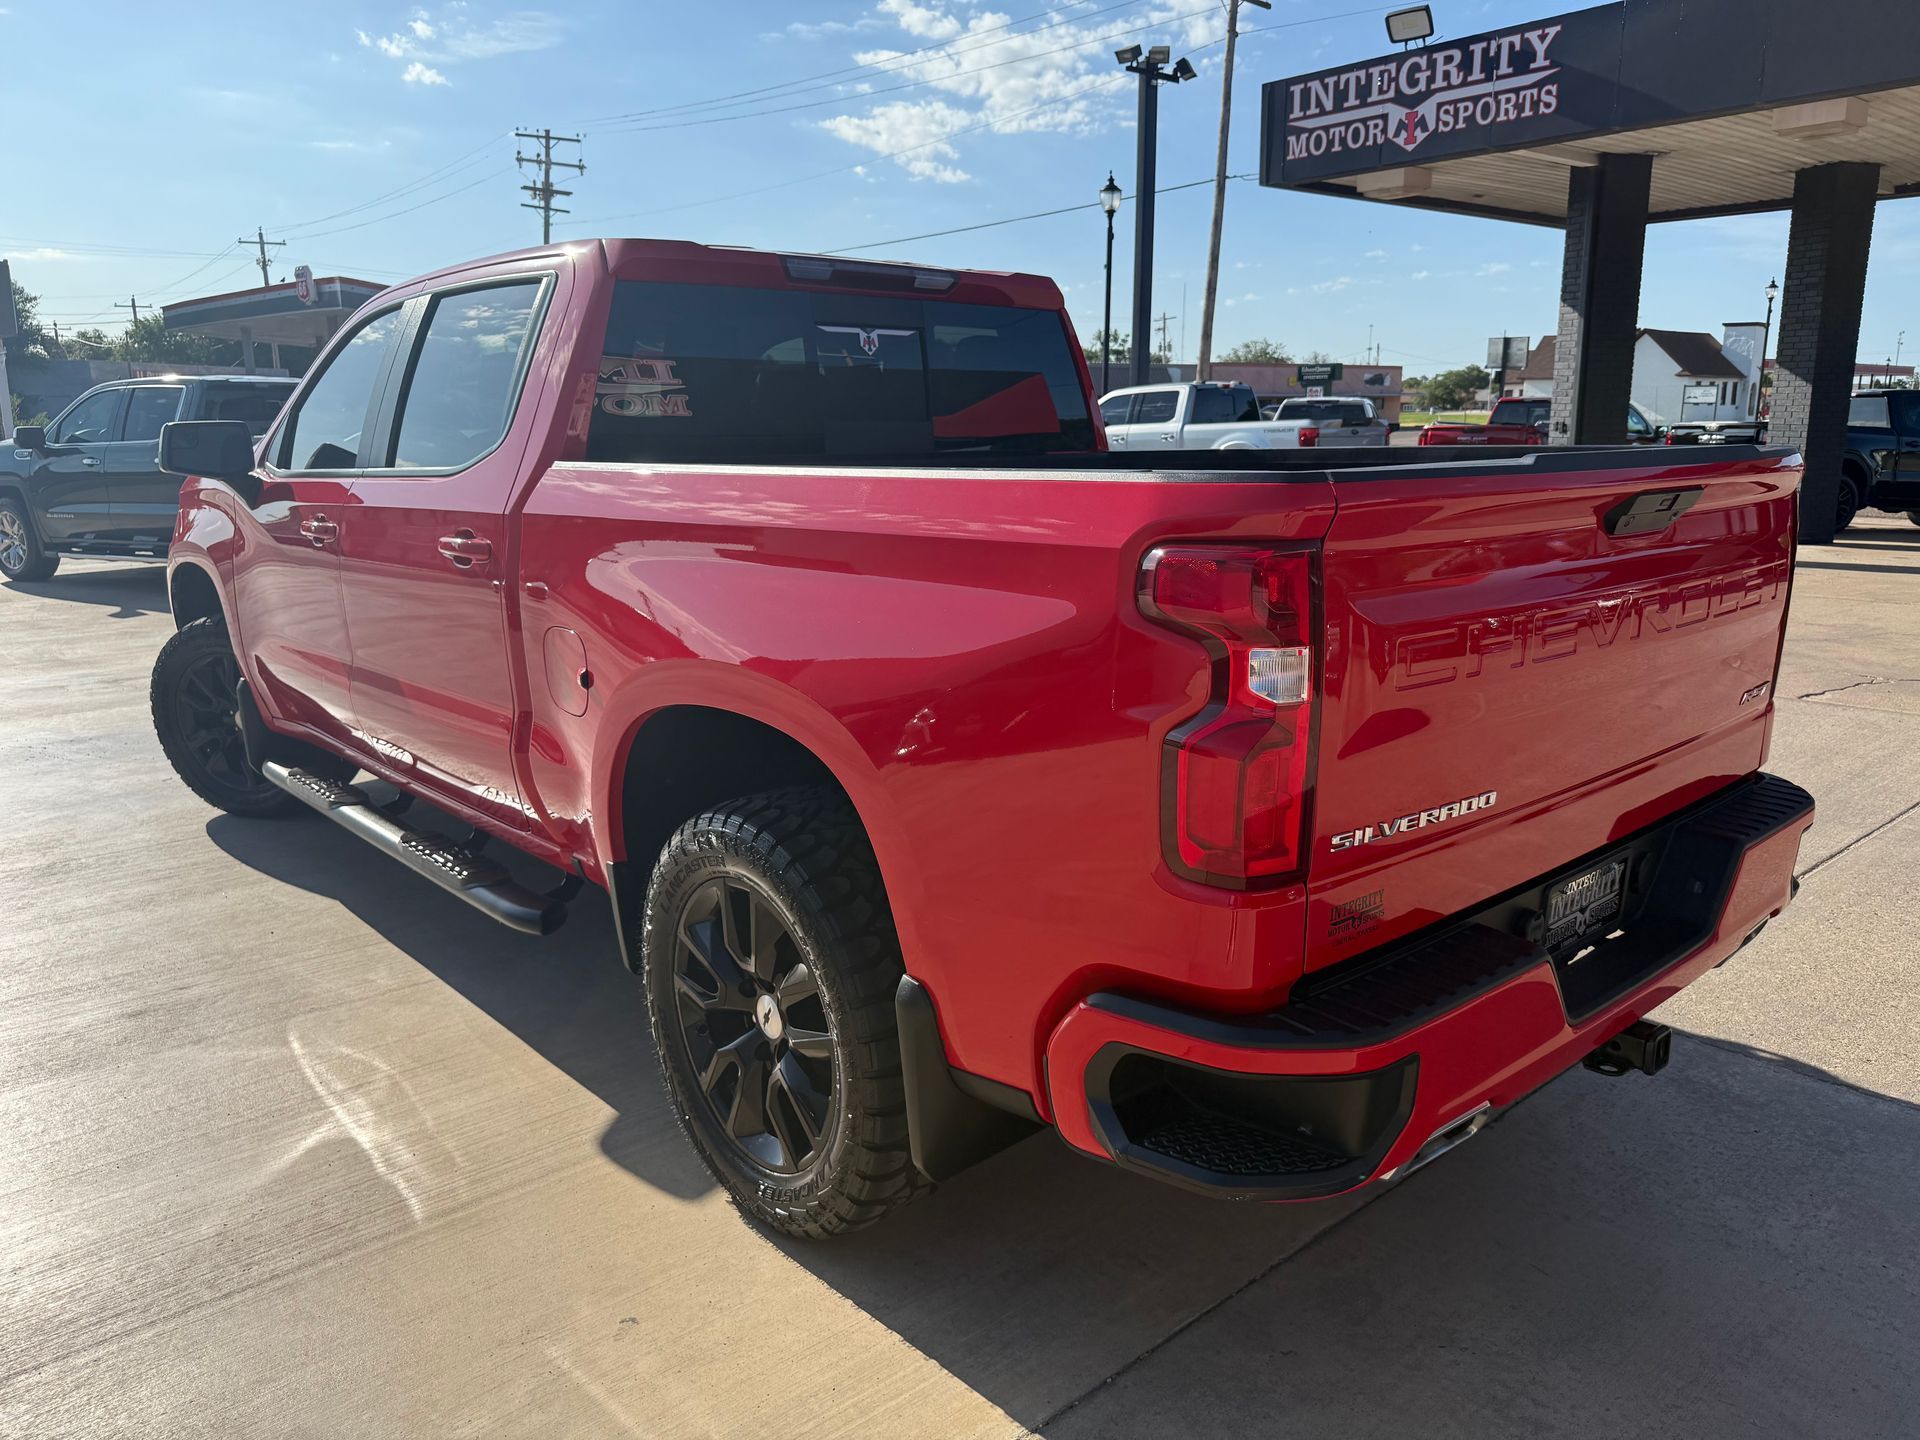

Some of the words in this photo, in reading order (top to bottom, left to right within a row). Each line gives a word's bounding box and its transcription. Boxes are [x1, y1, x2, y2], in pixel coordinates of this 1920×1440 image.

[1289, 25, 1561, 120] INTEGRITY
[1286, 118, 1386, 161] MOTOR
[1437, 83, 1560, 134] SPORTS
[1395, 558, 1787, 692] CHEVROLET
[1330, 790, 1498, 853] SILVERADO
[1330, 888, 1385, 922] INTEGRITY
